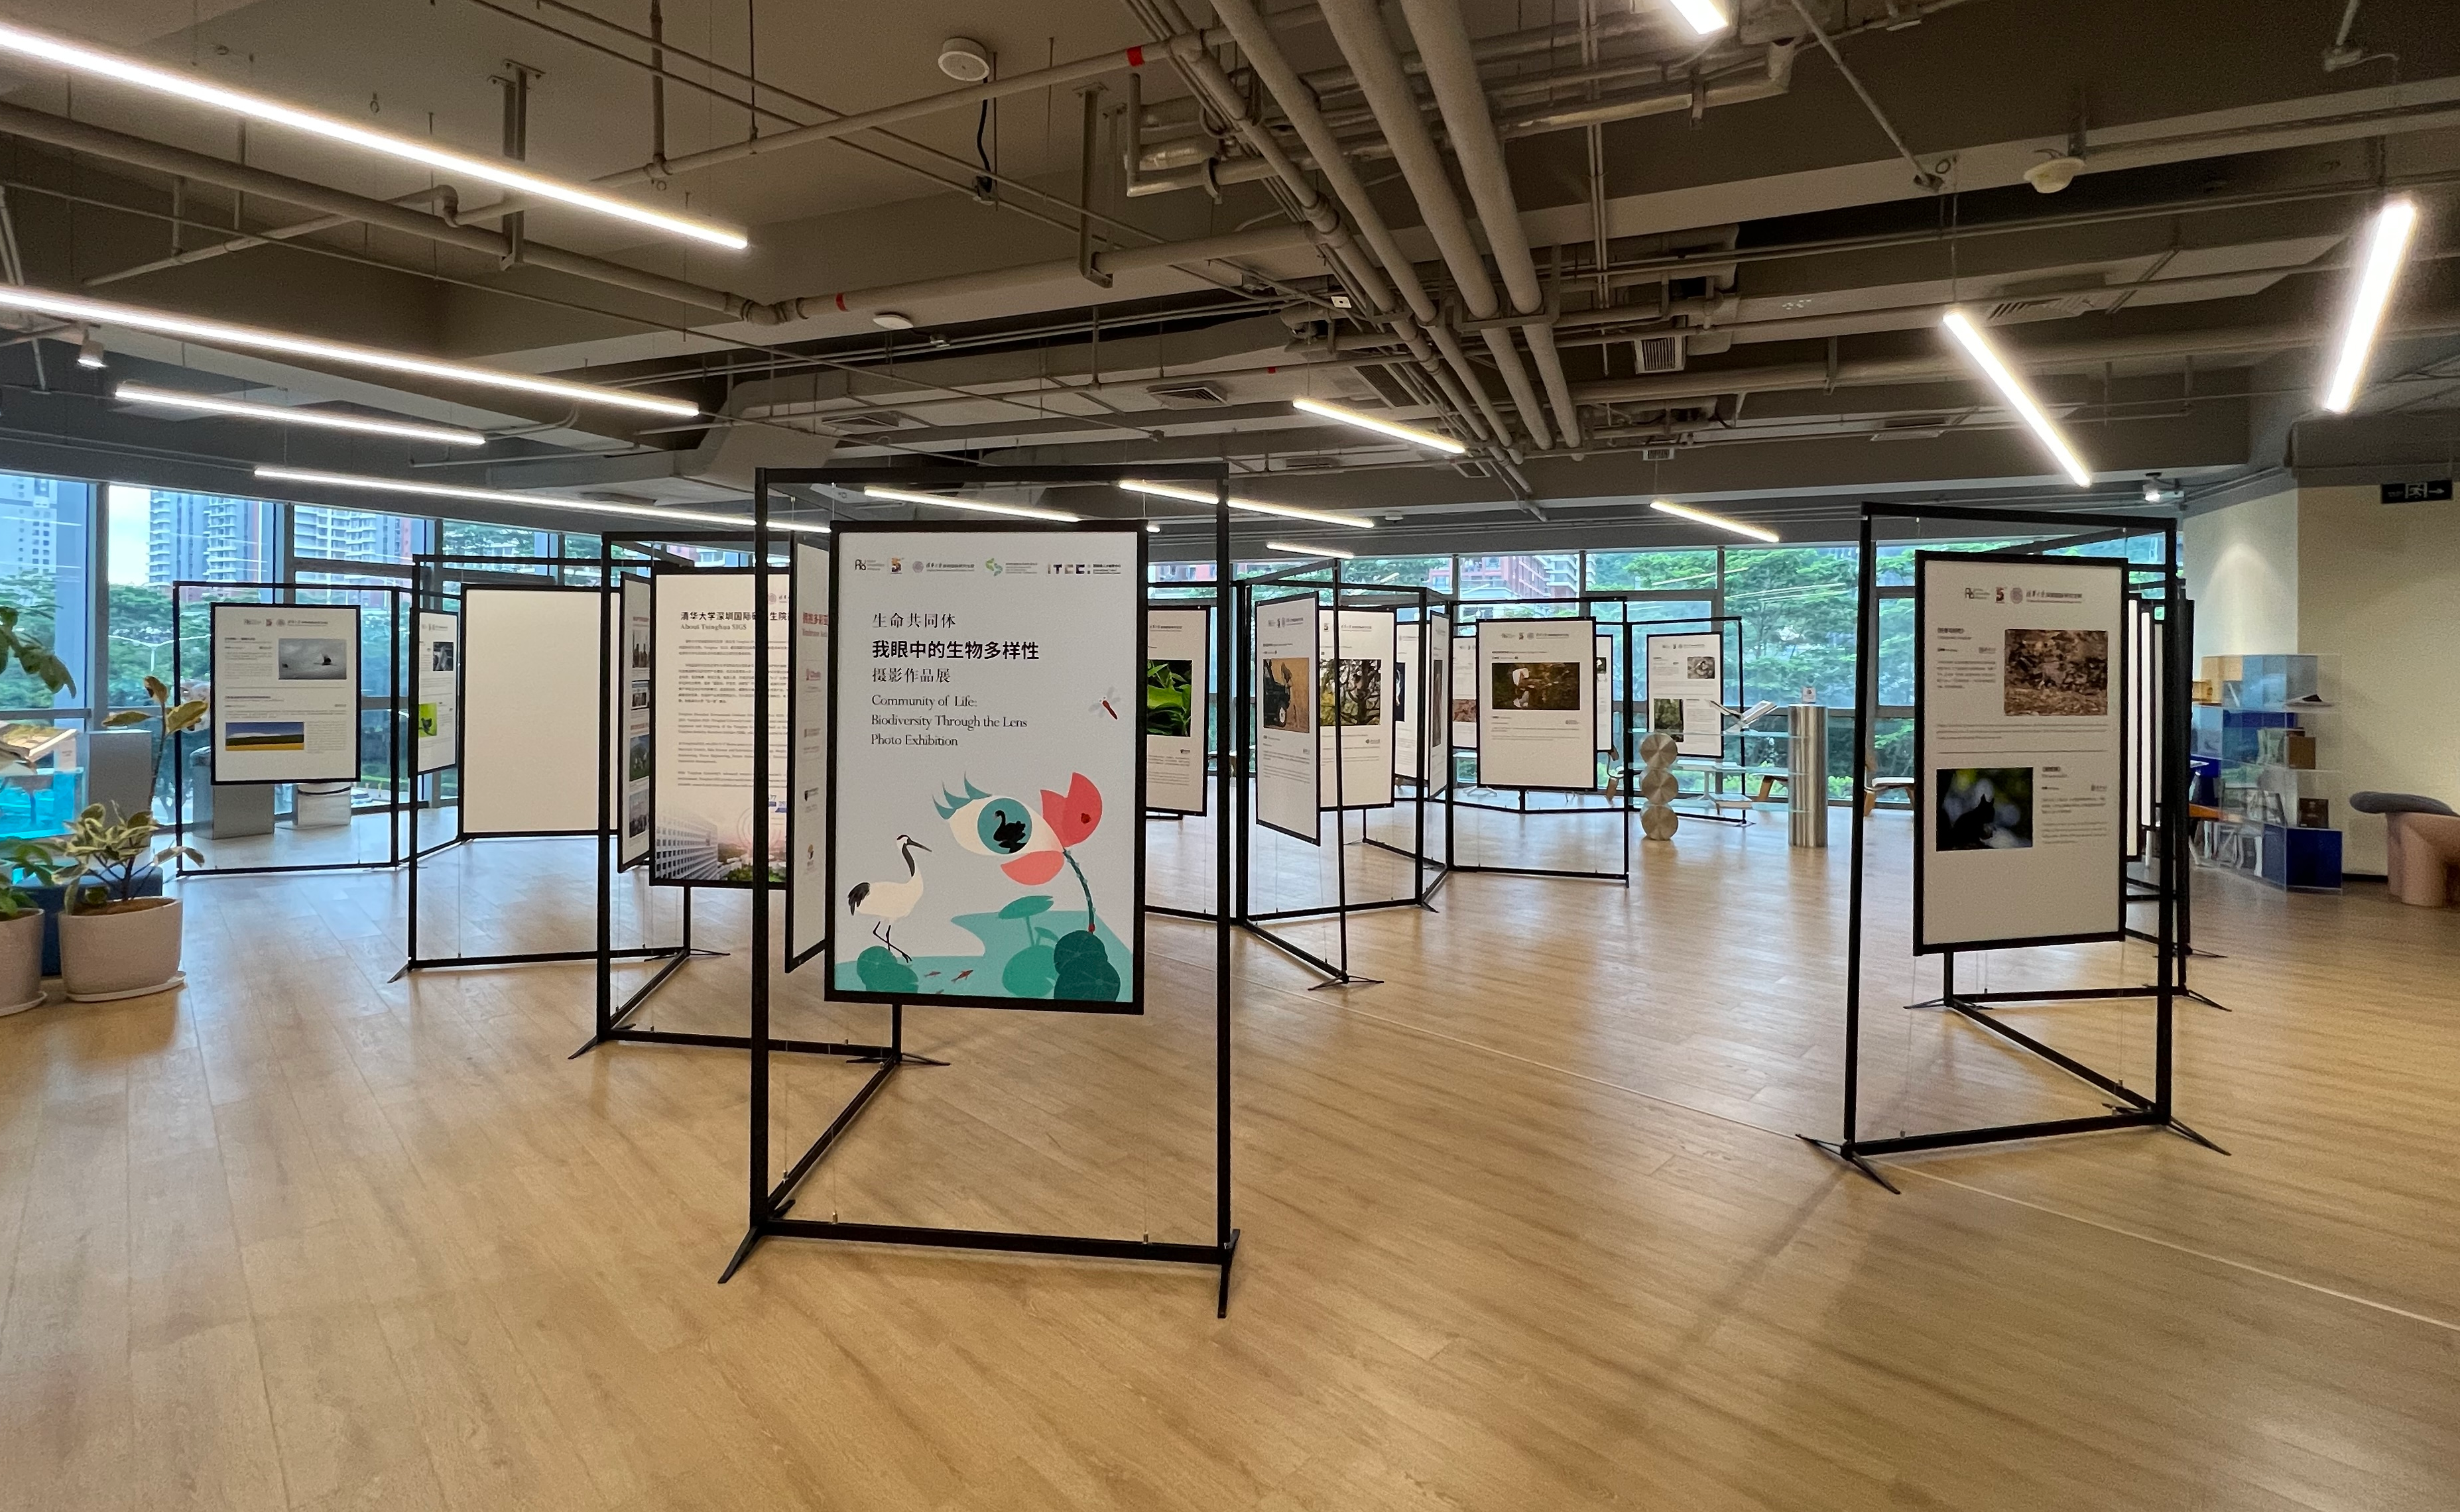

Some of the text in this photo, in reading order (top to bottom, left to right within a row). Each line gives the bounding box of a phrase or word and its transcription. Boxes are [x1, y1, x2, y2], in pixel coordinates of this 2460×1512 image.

[872, 612, 956, 629] 生命共同体
[872, 640, 1040, 660] 我眼中的生物多样性
[872, 668, 951, 683] 摄影作品展
[871, 695, 935, 711] Community
[938, 695, 950, 707] of
[871, 714, 1028, 731] Biodiversity Through the Lens
[871, 733, 958, 747] Photo Exhibition
